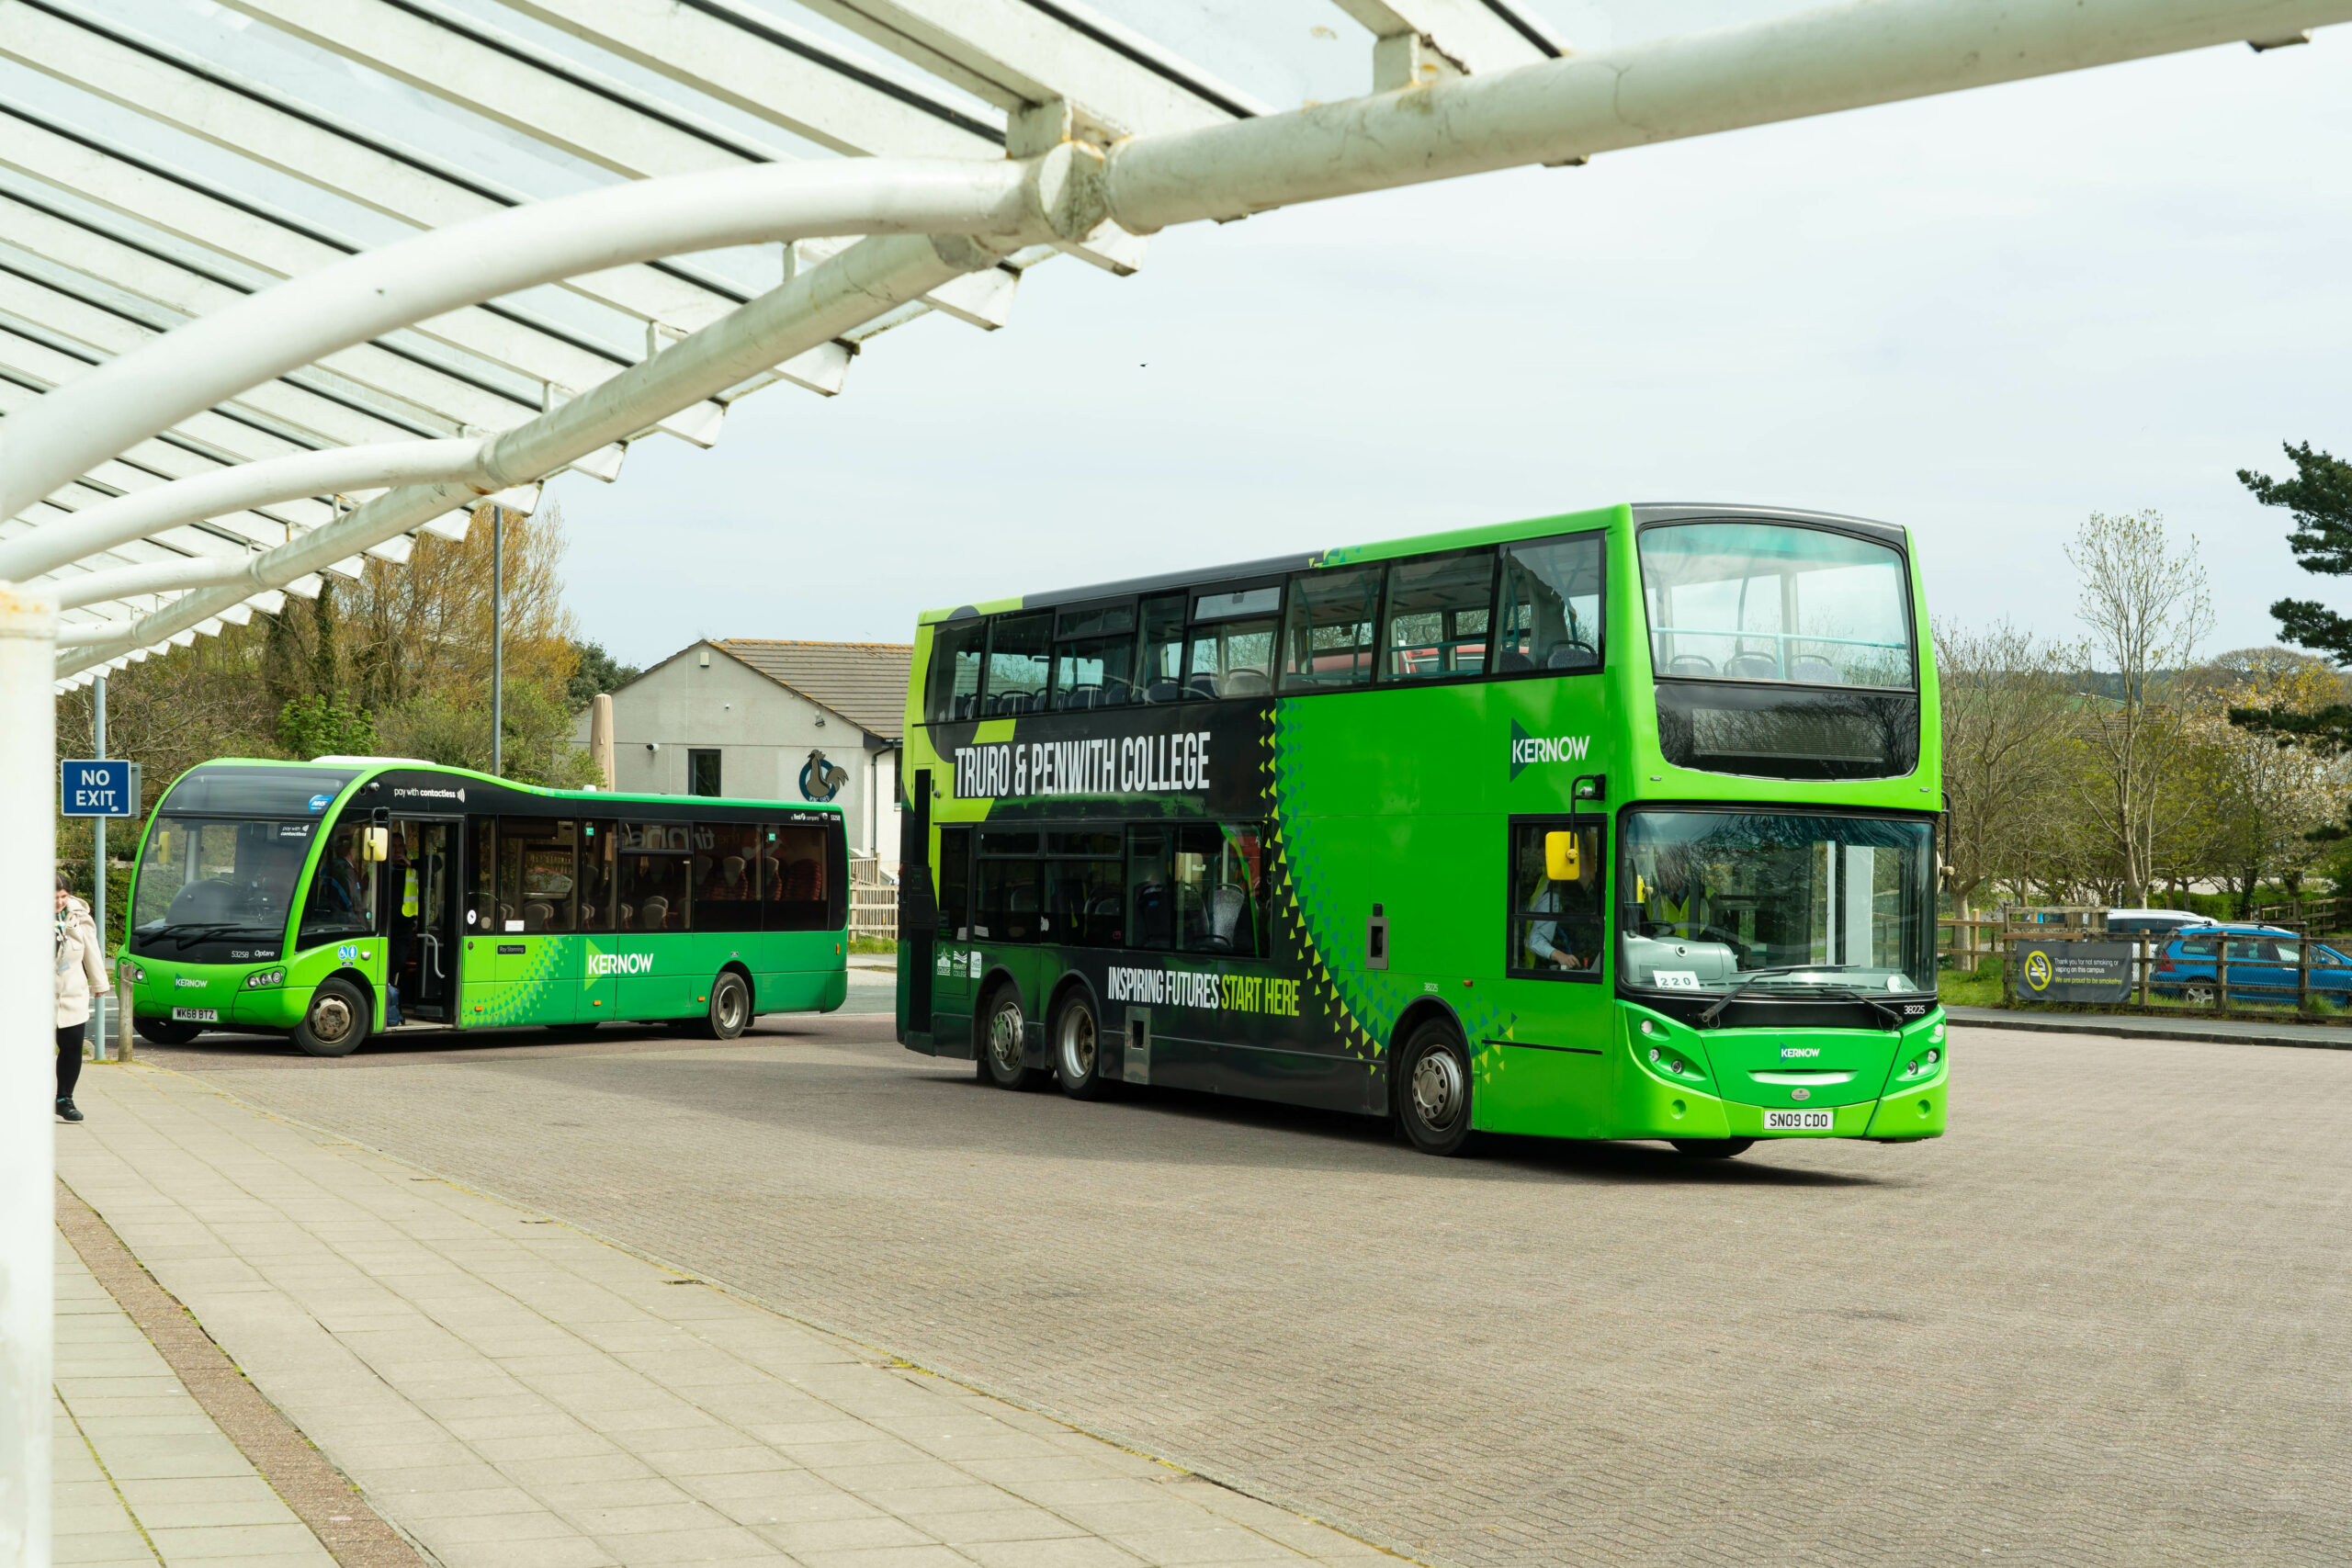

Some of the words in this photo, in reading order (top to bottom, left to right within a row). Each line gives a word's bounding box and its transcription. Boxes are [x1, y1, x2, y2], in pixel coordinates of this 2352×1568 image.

[1512, 735, 1590, 763] KERNOW
[955, 744, 1011, 797] TRURO
[1014, 744, 1027, 795] &
[1031, 739, 1115, 795] PENWITH
[1121, 731, 1211, 793] COLLEGE
[81, 769, 110, 786] NO
[394, 788, 405, 797] pay
[406, 787, 419, 796] with
[420, 789, 456, 798] contactless
[75, 790, 116, 807] EXIT
[231, 950, 249, 958] 53258
[588, 953, 654, 975] KERNOW
[2093, 959, 2113, 967] smoking
[175, 978, 208, 987] KERNOW
[1660, 977, 1691, 986] 220
[2071, 976, 2086, 985] proud
[1108, 966, 1163, 1004] INSPIRING
[1165, 970, 1220, 1010] FUTURES
[1221, 974, 1262, 1013] START
[1264, 977, 1301, 1017] HERE
[176, 1009, 197, 1019] WK68
[198, 1010, 214, 1020] BTZ
[1904, 1005, 1926, 1014] 38225
[1781, 1047, 1821, 1058] KERNOW
[1770, 1113, 1801, 1127] SN09
[1804, 1113, 1828, 1128] CDO
